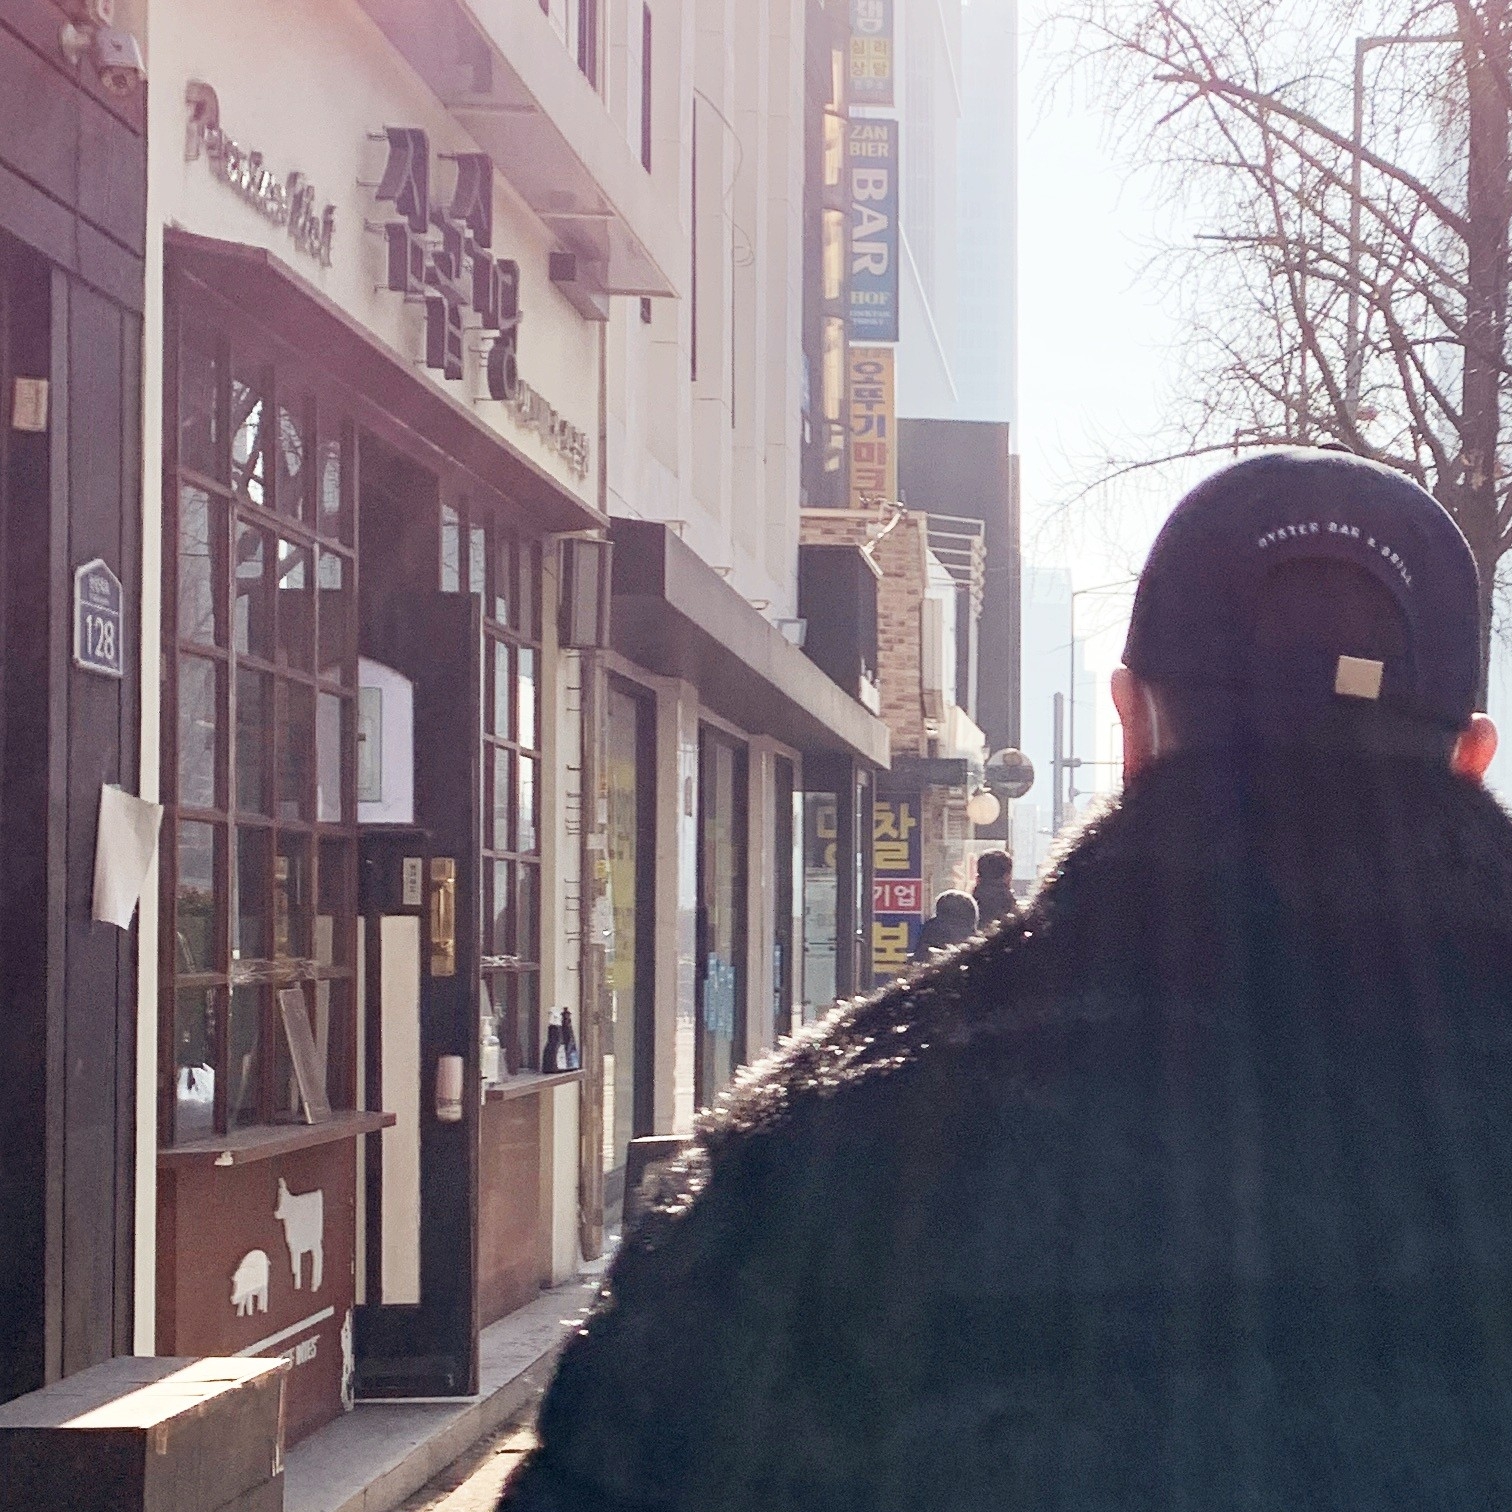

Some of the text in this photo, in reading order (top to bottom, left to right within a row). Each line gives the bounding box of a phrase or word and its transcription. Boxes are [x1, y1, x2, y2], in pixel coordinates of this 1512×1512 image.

[850, 125, 888, 141] ZAN
[850, 142, 888, 157] BIER
[852, 169, 888, 276] BAR
[851, 291, 889, 305] HOF
[1327, 521, 1361, 539] BAR
[86, 614, 115, 660] 128
